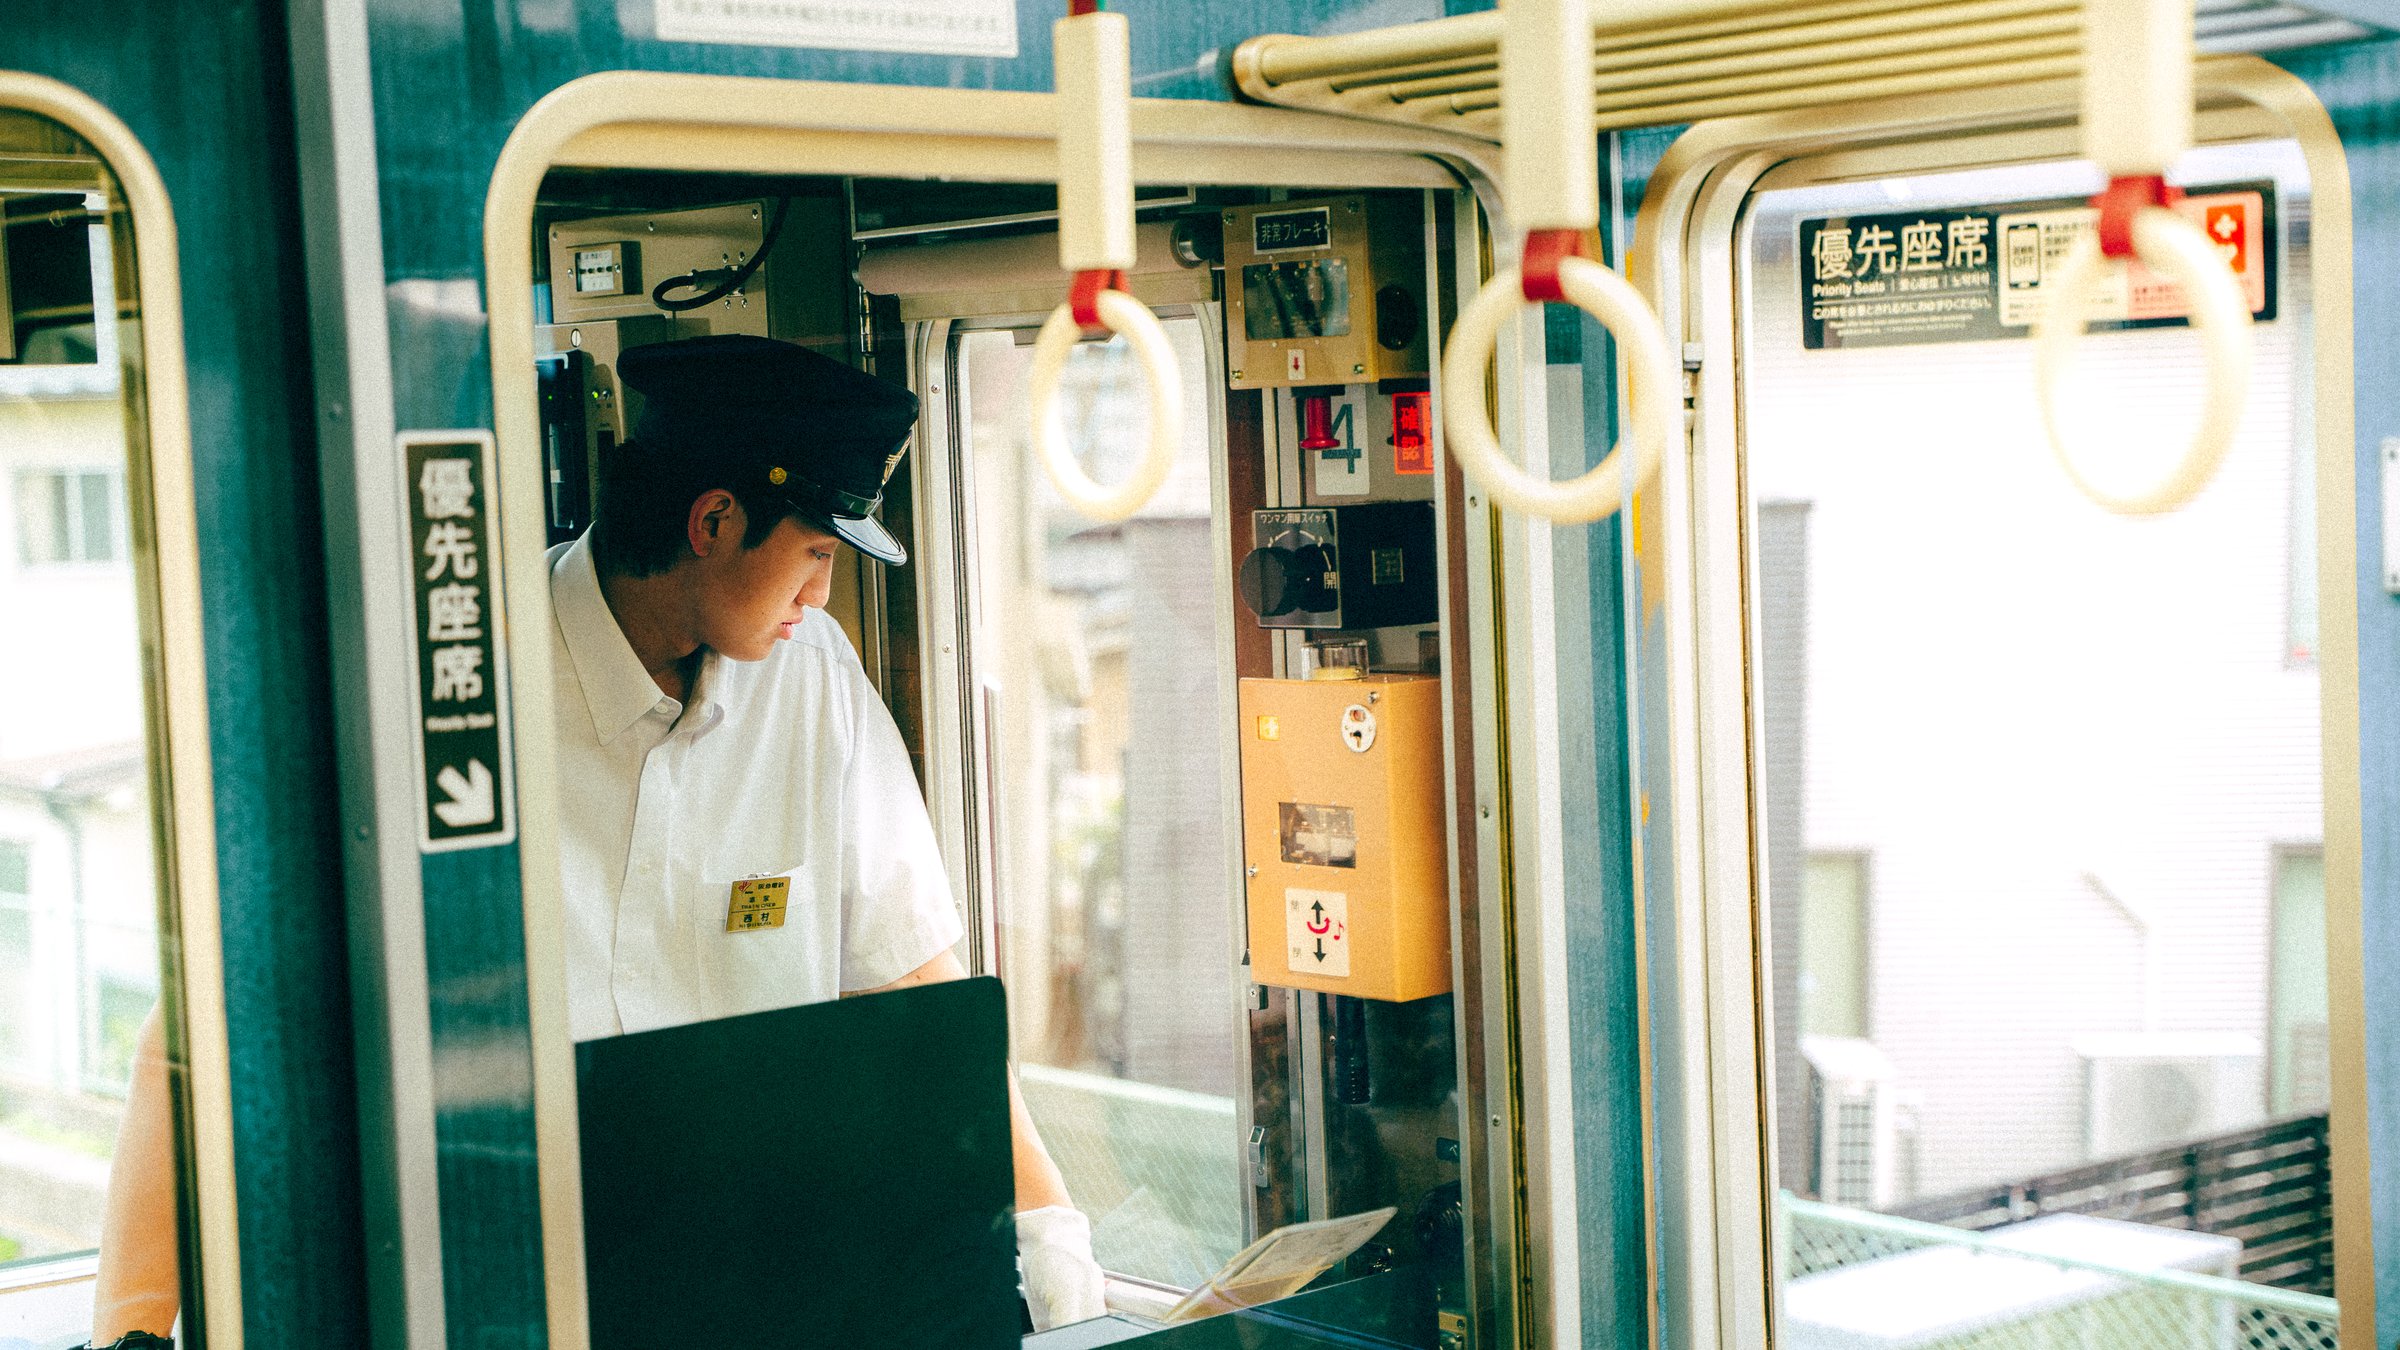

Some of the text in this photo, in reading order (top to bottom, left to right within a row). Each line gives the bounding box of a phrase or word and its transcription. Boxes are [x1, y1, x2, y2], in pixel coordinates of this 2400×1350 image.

[1261, 220, 1322, 244] 非常ブレーキ
[1811, 215, 1989, 280] 優先座席
[1812, 282, 1852, 298] Priority
[1854, 280, 1886, 295] Seats
[1321, 404, 1362, 474] 4
[418, 457, 484, 702] 優先座席
[1323, 571, 1337, 589] 開
